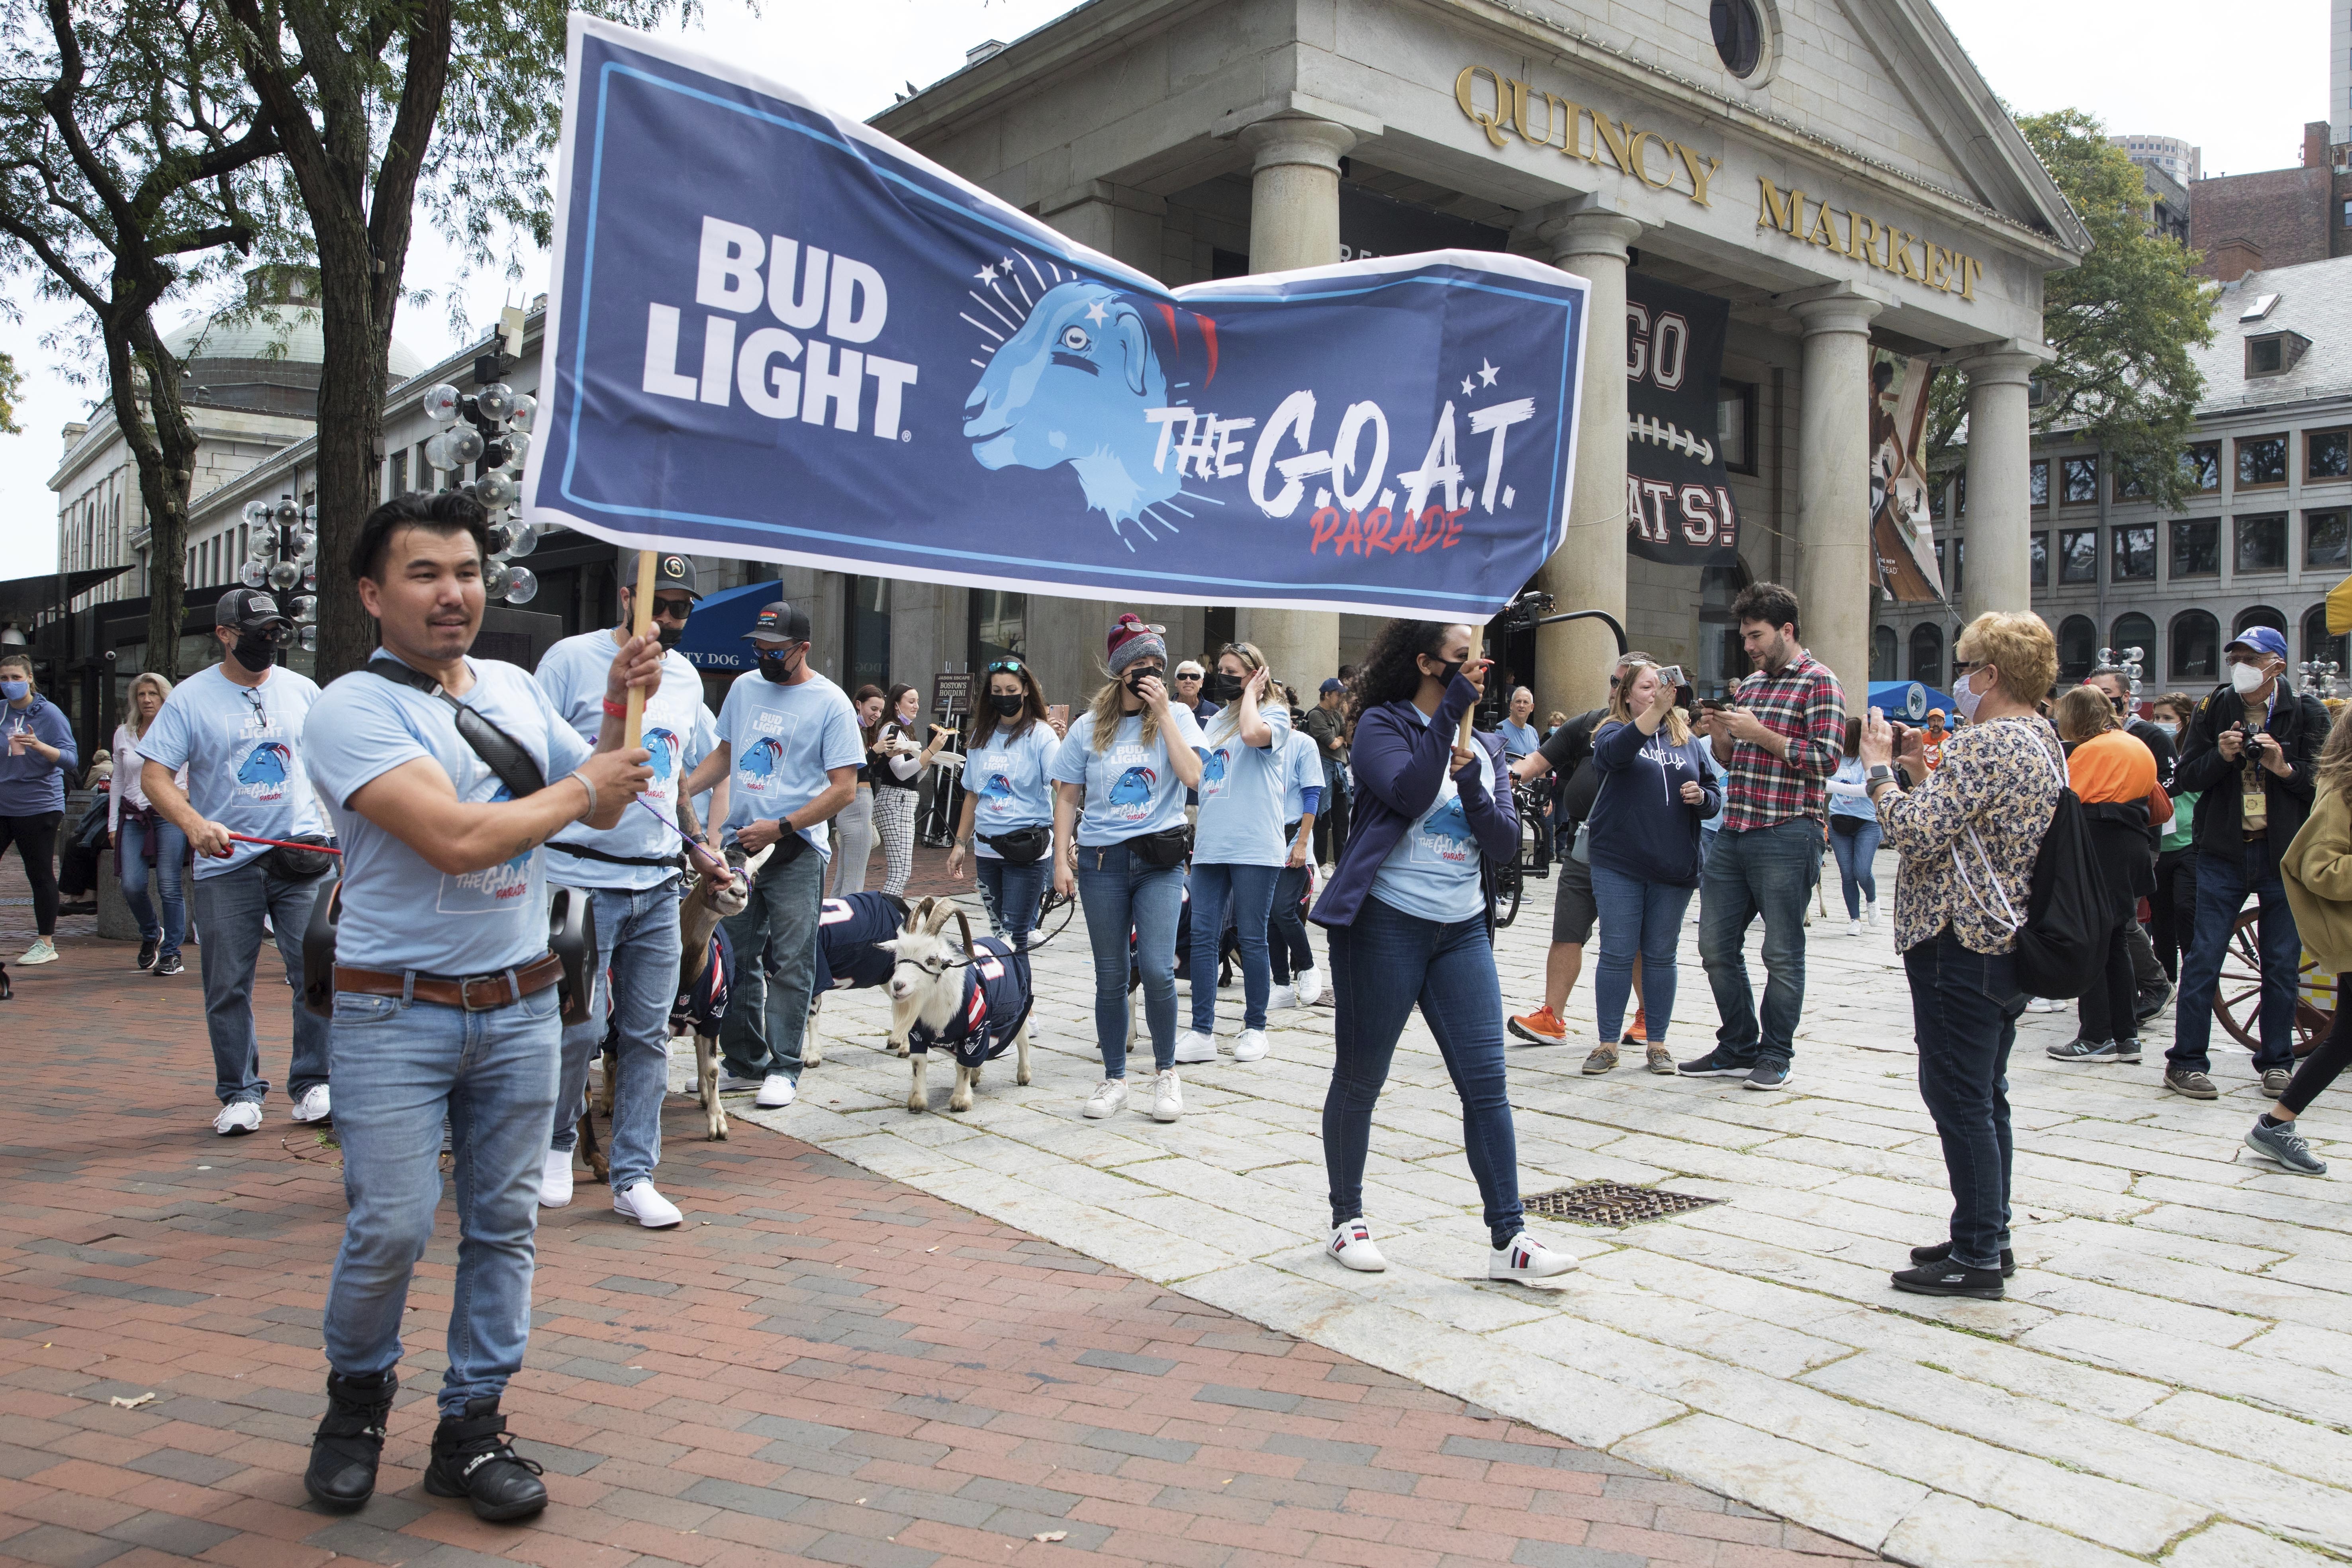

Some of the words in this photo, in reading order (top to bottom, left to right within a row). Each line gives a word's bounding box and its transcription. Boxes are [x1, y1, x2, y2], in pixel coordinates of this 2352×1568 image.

[1455, 65, 1722, 208] QUINCY
[1757, 176, 1983, 301] MARKET
[696, 215, 888, 343] BUD
[1626, 300, 1689, 391] GO
[643, 302, 918, 440] LIGHT
[1144, 407, 1255, 481] THE
[1248, 390, 1535, 522] G.O.A.T.
[1627, 473, 1734, 546] ATS!
[1310, 506, 1469, 558] PARADE
[708, 654, 739, 666] DOG
[2186, 660, 2207, 669] ANTHEM
[649, 698, 670, 711] UD
[2200, 697, 2209, 710] Nikon
[244, 717, 277, 728] BD
[760, 712, 783, 725] BUD
[239, 727, 284, 739] LIGHT
[752, 720, 785, 736] LIGHT
[1116, 744, 1144, 756] BUD
[988, 755, 1008, 764] BUD
[1111, 753, 1150, 764] LIGHT
[983, 762, 1009, 771] LIGHT
[237, 787, 252, 795] THE
[644, 790, 666, 799] PARADE
[259, 793, 282, 802] PARADE
[1418, 837, 1434, 848] THE
[1443, 852, 1466, 861] PARADE
[456, 873, 483, 889] THE
[495, 883, 527, 900] PARADE
